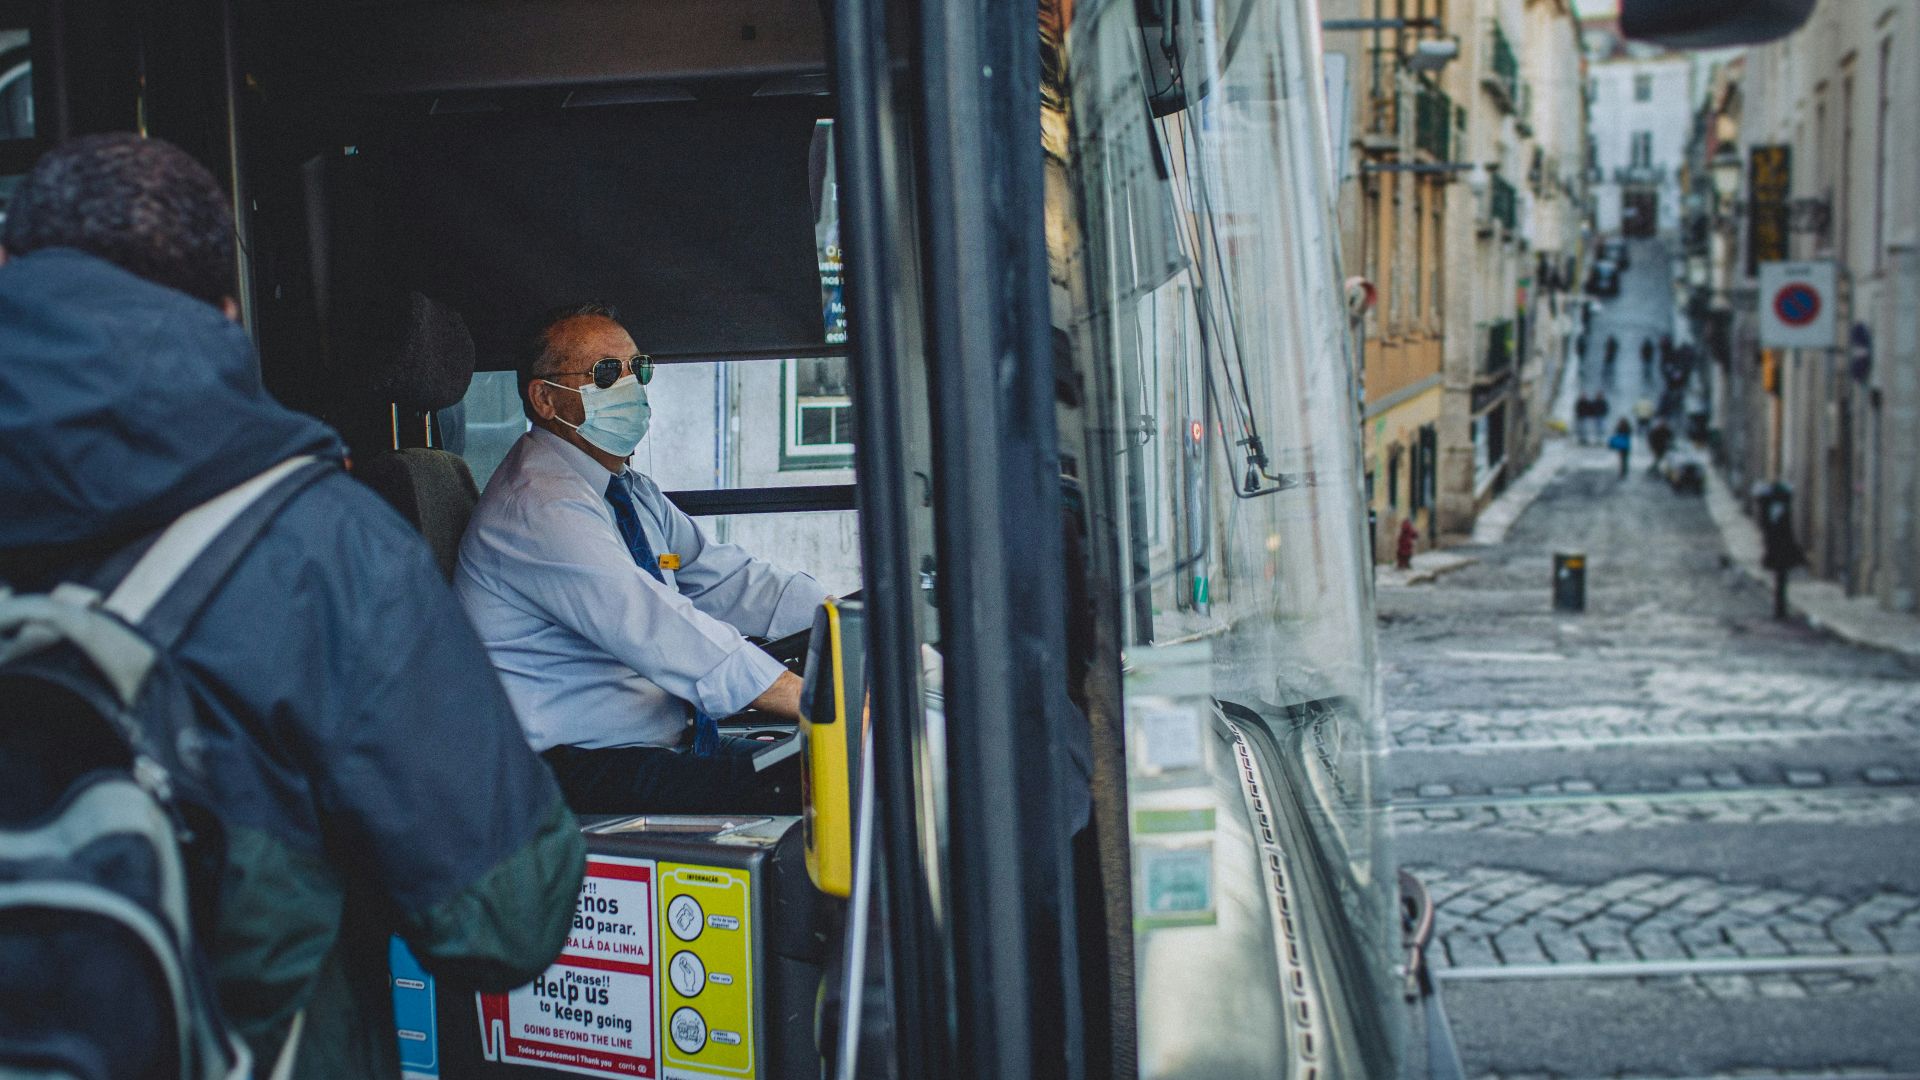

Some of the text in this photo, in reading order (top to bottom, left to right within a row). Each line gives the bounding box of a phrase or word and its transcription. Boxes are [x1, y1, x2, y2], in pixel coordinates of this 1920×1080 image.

[573, 909, 636, 936] ão parar.
[582, 936, 594, 950] LÁ
[597, 940, 610, 952] DA
[613, 942, 644, 956] LINHA
[533, 975, 609, 1006] Help us
[565, 970, 610, 988] Please!!
[540, 1000, 632, 1033] to keep going
[524, 1023, 633, 1049] GOING BEYOND THE LINE
[518, 1045, 536, 1055] Todos
[536, 1048, 576, 1062] agradecemos
[580, 1054, 600, 1065] Thank
[600, 1059, 612, 1068] you
